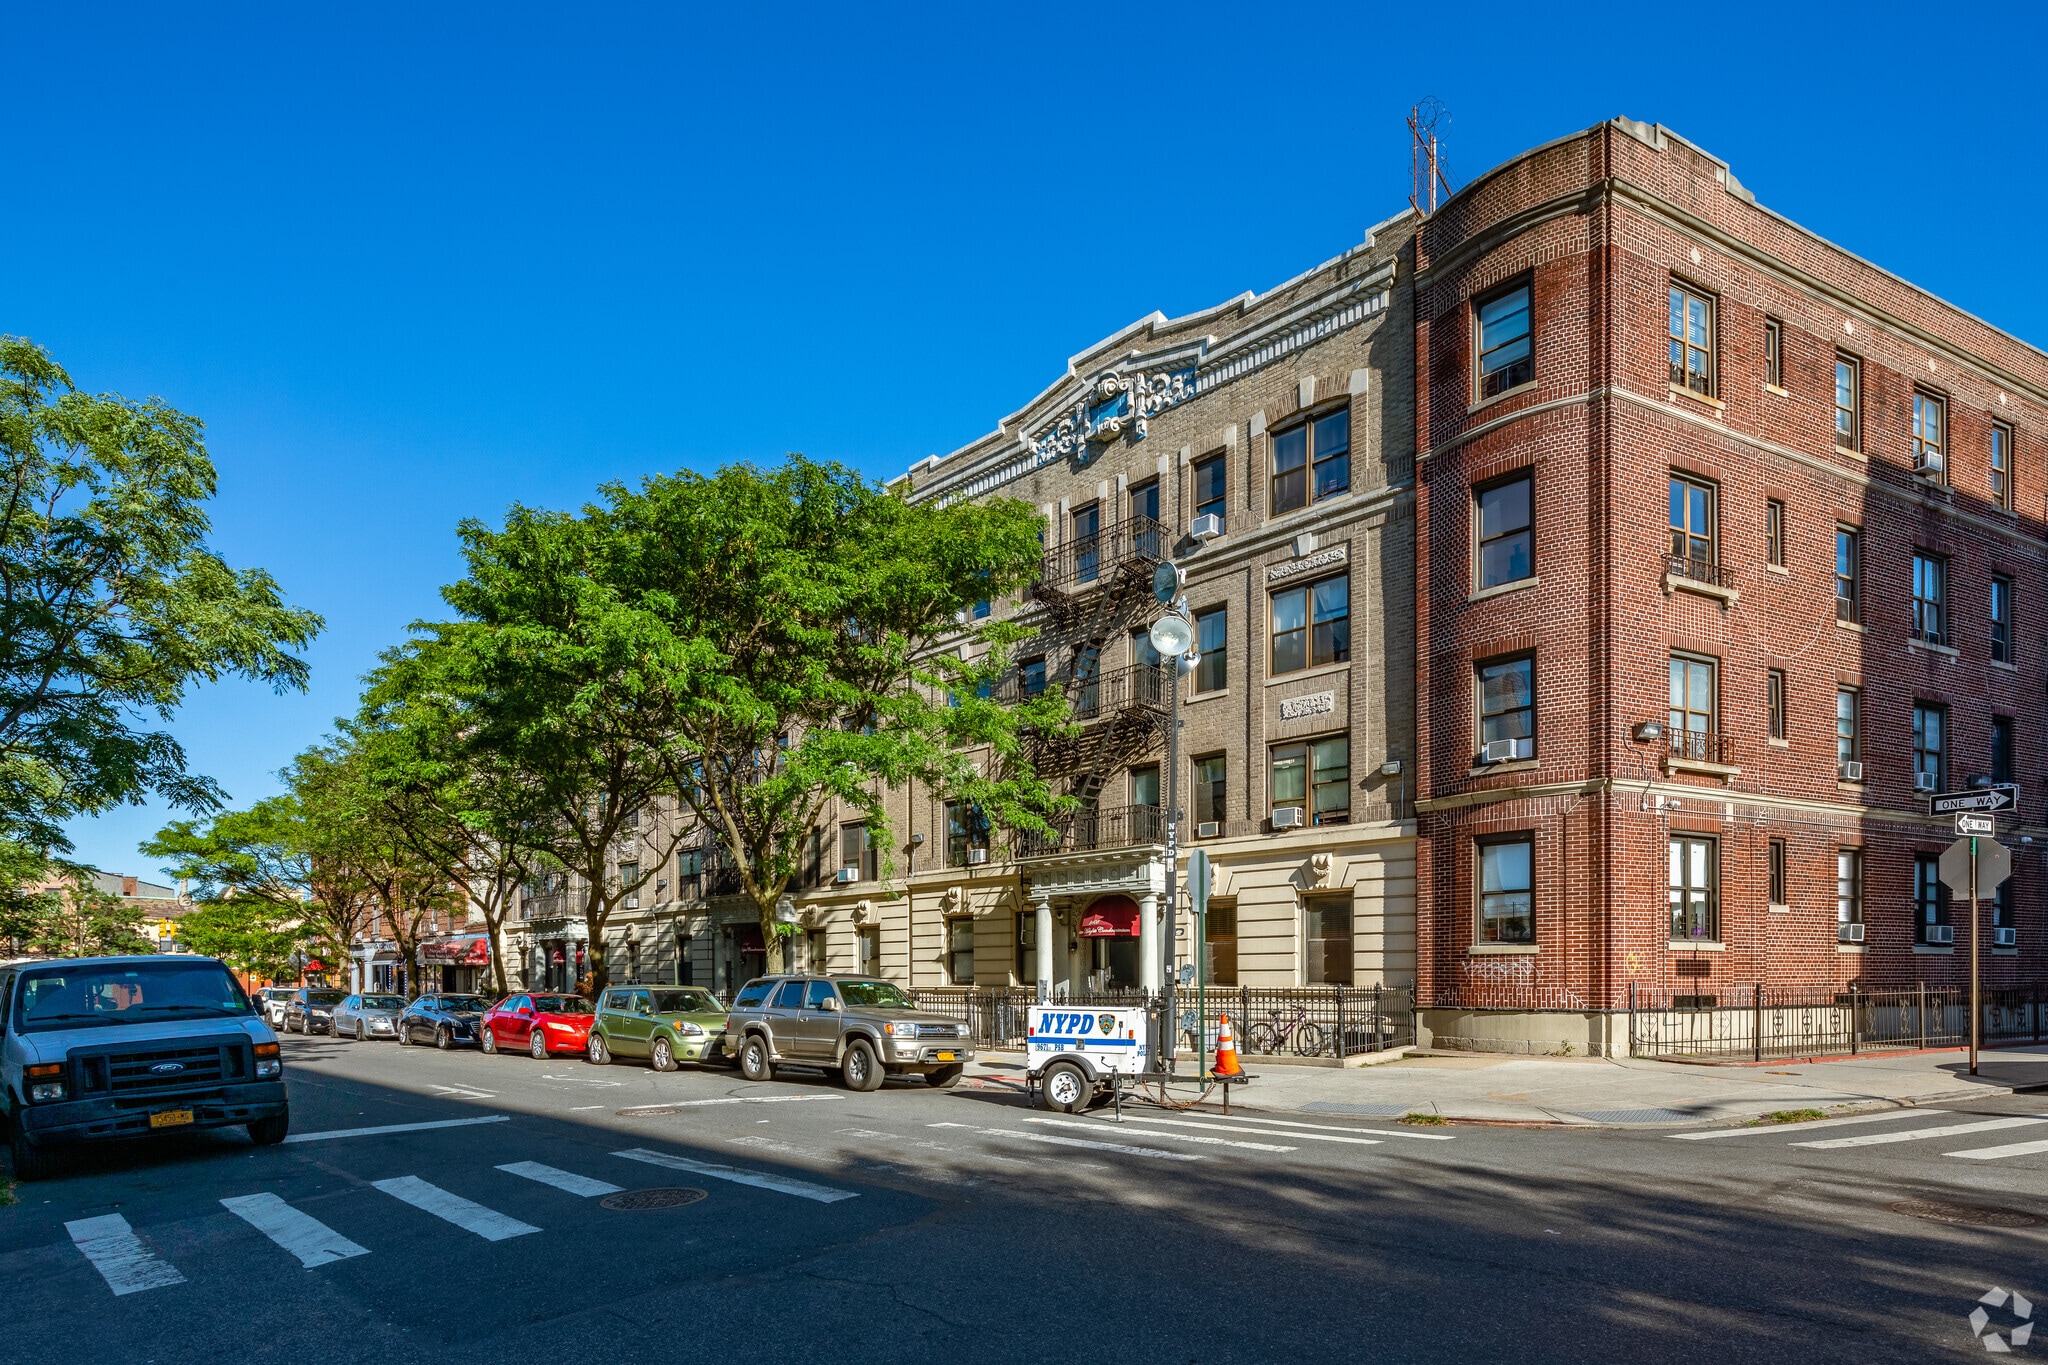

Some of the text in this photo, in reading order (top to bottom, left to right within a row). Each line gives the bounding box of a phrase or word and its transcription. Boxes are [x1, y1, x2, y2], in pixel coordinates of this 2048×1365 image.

[1942, 796, 2002, 809] ONE WAY
[1962, 819, 1990, 829] ONE WAY
[1038, 1013, 1094, 1035] NYPD
